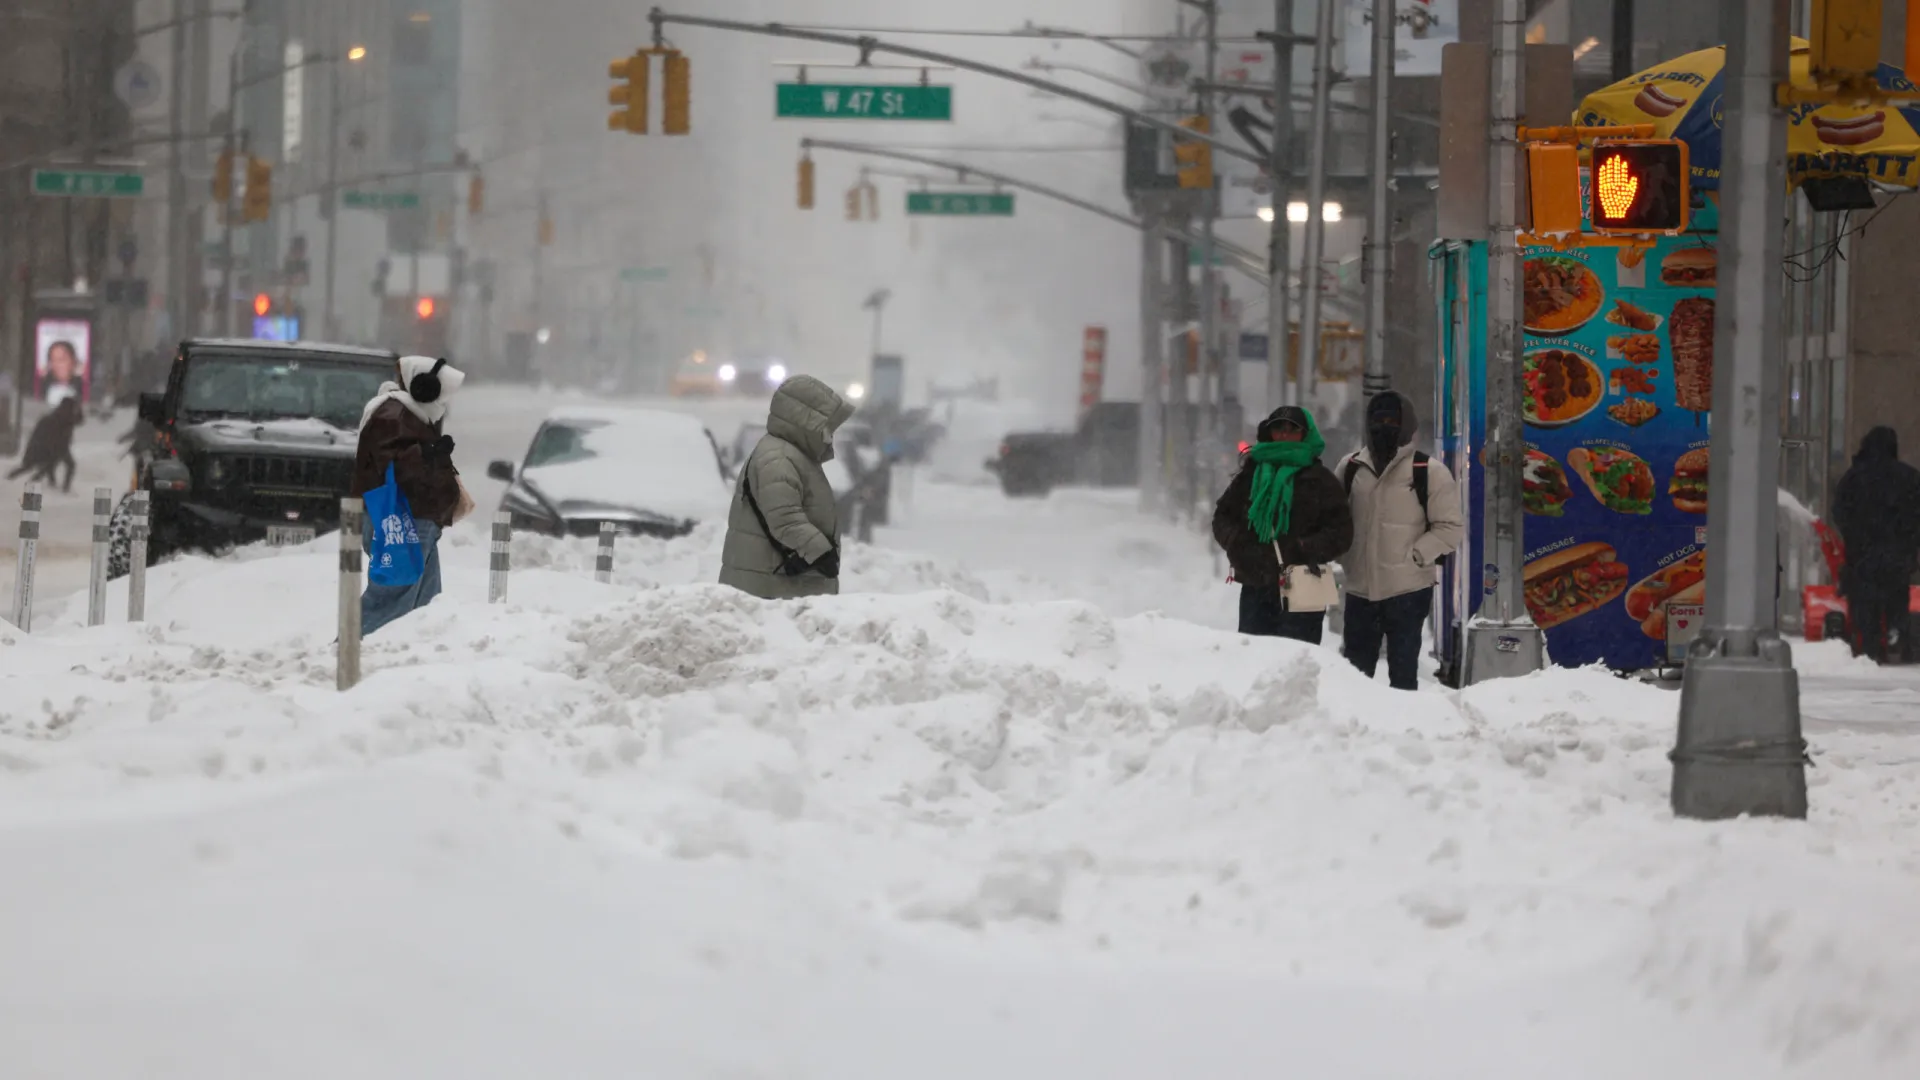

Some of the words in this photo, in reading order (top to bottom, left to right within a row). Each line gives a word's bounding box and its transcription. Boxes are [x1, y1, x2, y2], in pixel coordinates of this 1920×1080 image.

[821, 89, 841, 113] W
[847, 89, 875, 114] 47
[881, 90, 905, 115] St
[1566, 248, 1591, 261] RICE
[1544, 337, 1570, 347] OVER
[1573, 342, 1597, 356] RICE
[1522, 441, 1540, 450] YRO
[1536, 536, 1576, 556] SAUSAGE
[1657, 552, 1675, 568] HOT
[1675, 543, 1696, 558] DOG
[1669, 606, 1696, 616] Corn
